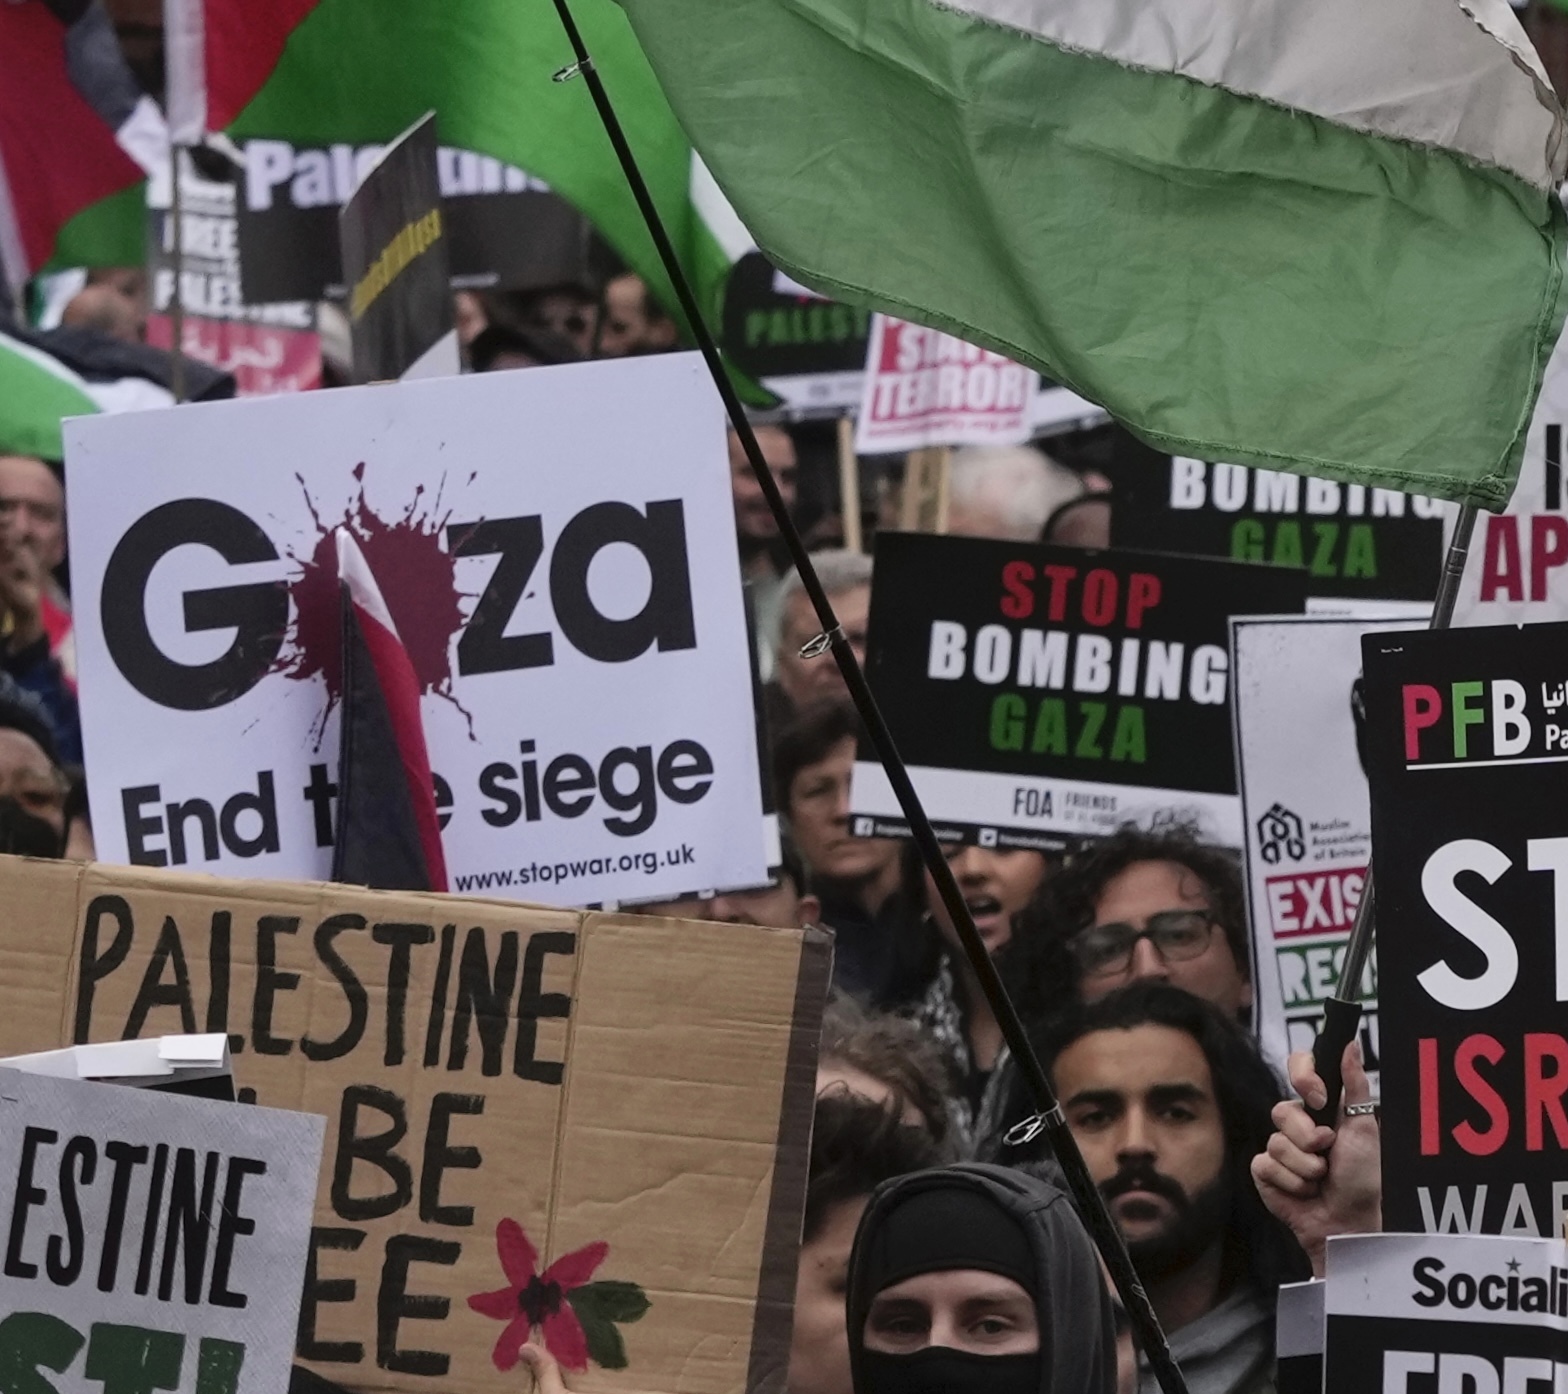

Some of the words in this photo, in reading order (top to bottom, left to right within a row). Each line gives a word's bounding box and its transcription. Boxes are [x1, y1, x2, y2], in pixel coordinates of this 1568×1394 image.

[1231, 519, 1379, 580] GAZA
[100, 497, 697, 711] Gza
[1002, 560, 1162, 629] STOP
[927, 620, 1228, 705] BOMBING
[990, 693, 1148, 764] GAZA
[1402, 679, 1531, 761] PFB
[121, 770, 279, 867] End
[480, 737, 715, 837] siege
[1012, 788, 1053, 819] FOA
[455, 842, 697, 894] www.stopwar.org.uk
[74, 895, 577, 1085] PALESTINE
[330, 1085, 486, 1228] BE
